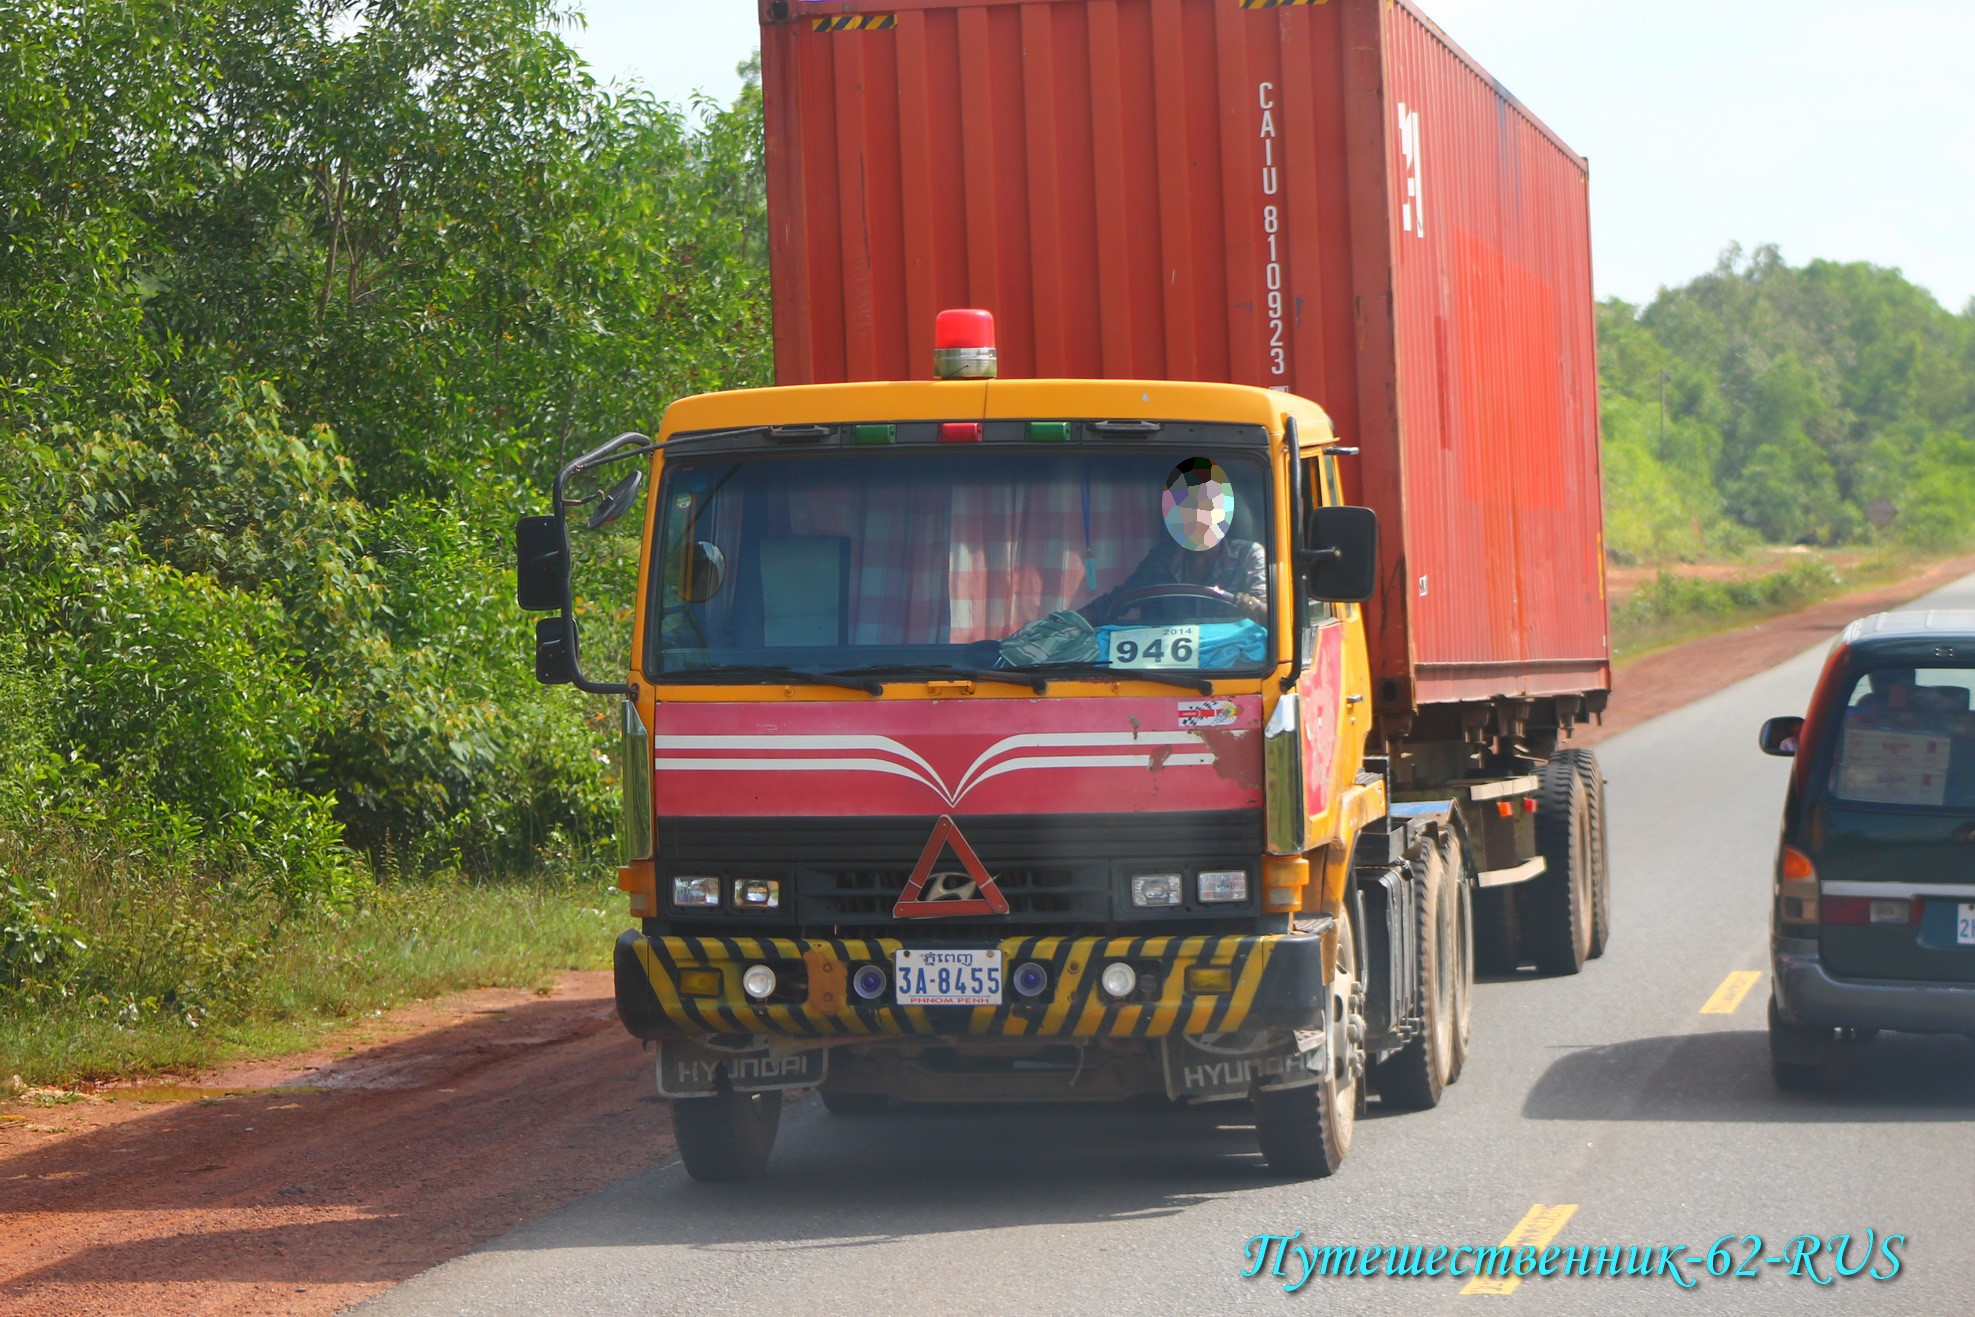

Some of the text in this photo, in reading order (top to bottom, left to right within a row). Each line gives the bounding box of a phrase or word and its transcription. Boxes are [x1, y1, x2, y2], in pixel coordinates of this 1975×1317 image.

[1259, 82, 1284, 375] CAIU 810923
[1163, 628, 1192, 636] 2014
[1116, 637, 1193, 663] 946
[899, 967, 999, 994] 3A-8455
